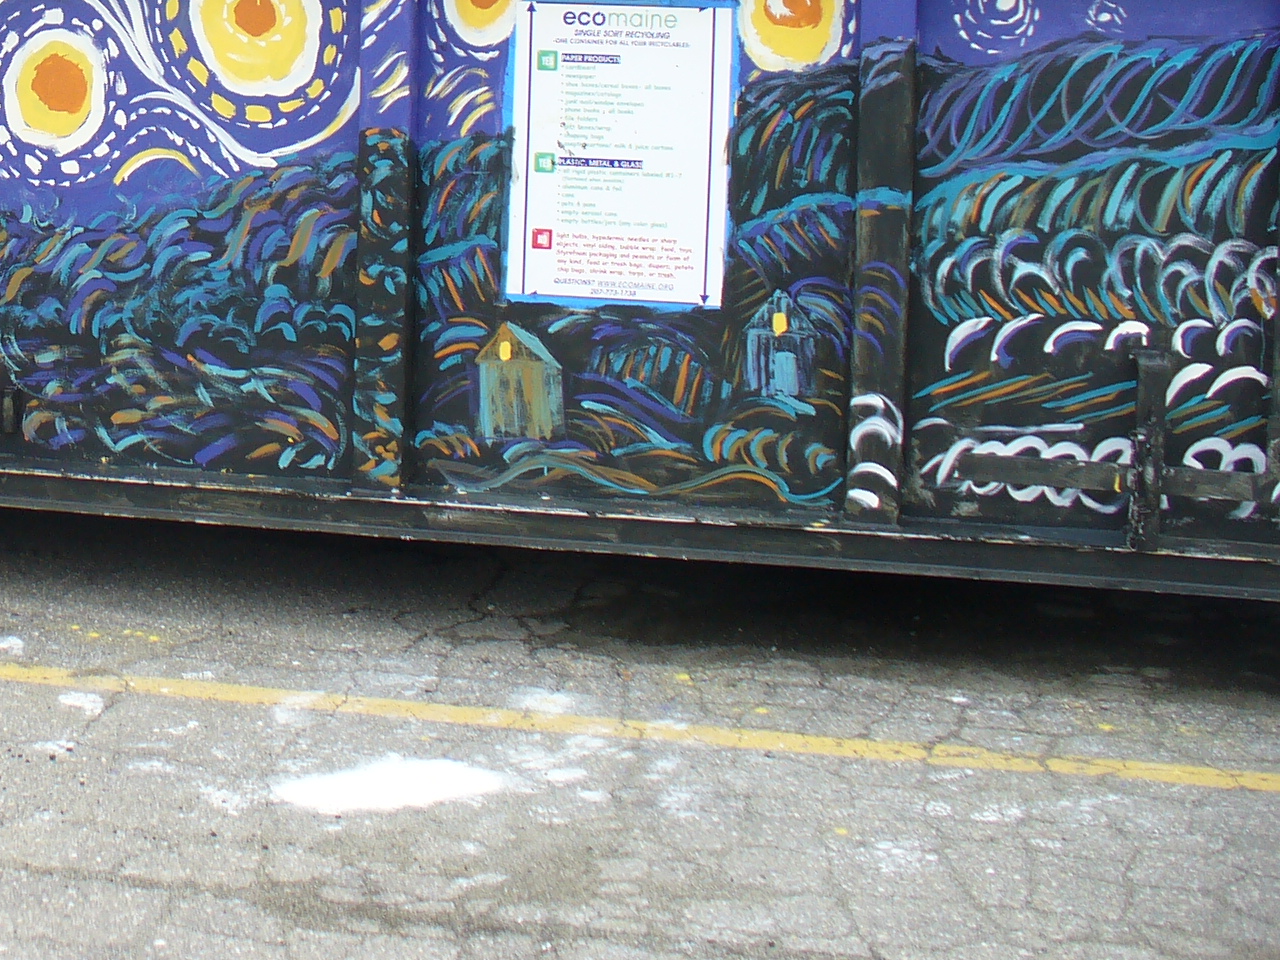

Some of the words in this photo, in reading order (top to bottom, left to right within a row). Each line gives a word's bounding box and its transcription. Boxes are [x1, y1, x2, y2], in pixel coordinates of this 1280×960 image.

[563, 10, 677, 29] ecomaine
[574, 29, 601, 37] SINGLE
[603, 30, 624, 38] SORT
[625, 31, 670, 39] RECYCLING
[562, 54, 582, 62] PAPER
[584, 55, 620, 63] PRODUCTS
[621, 161, 642, 169] GLASS
